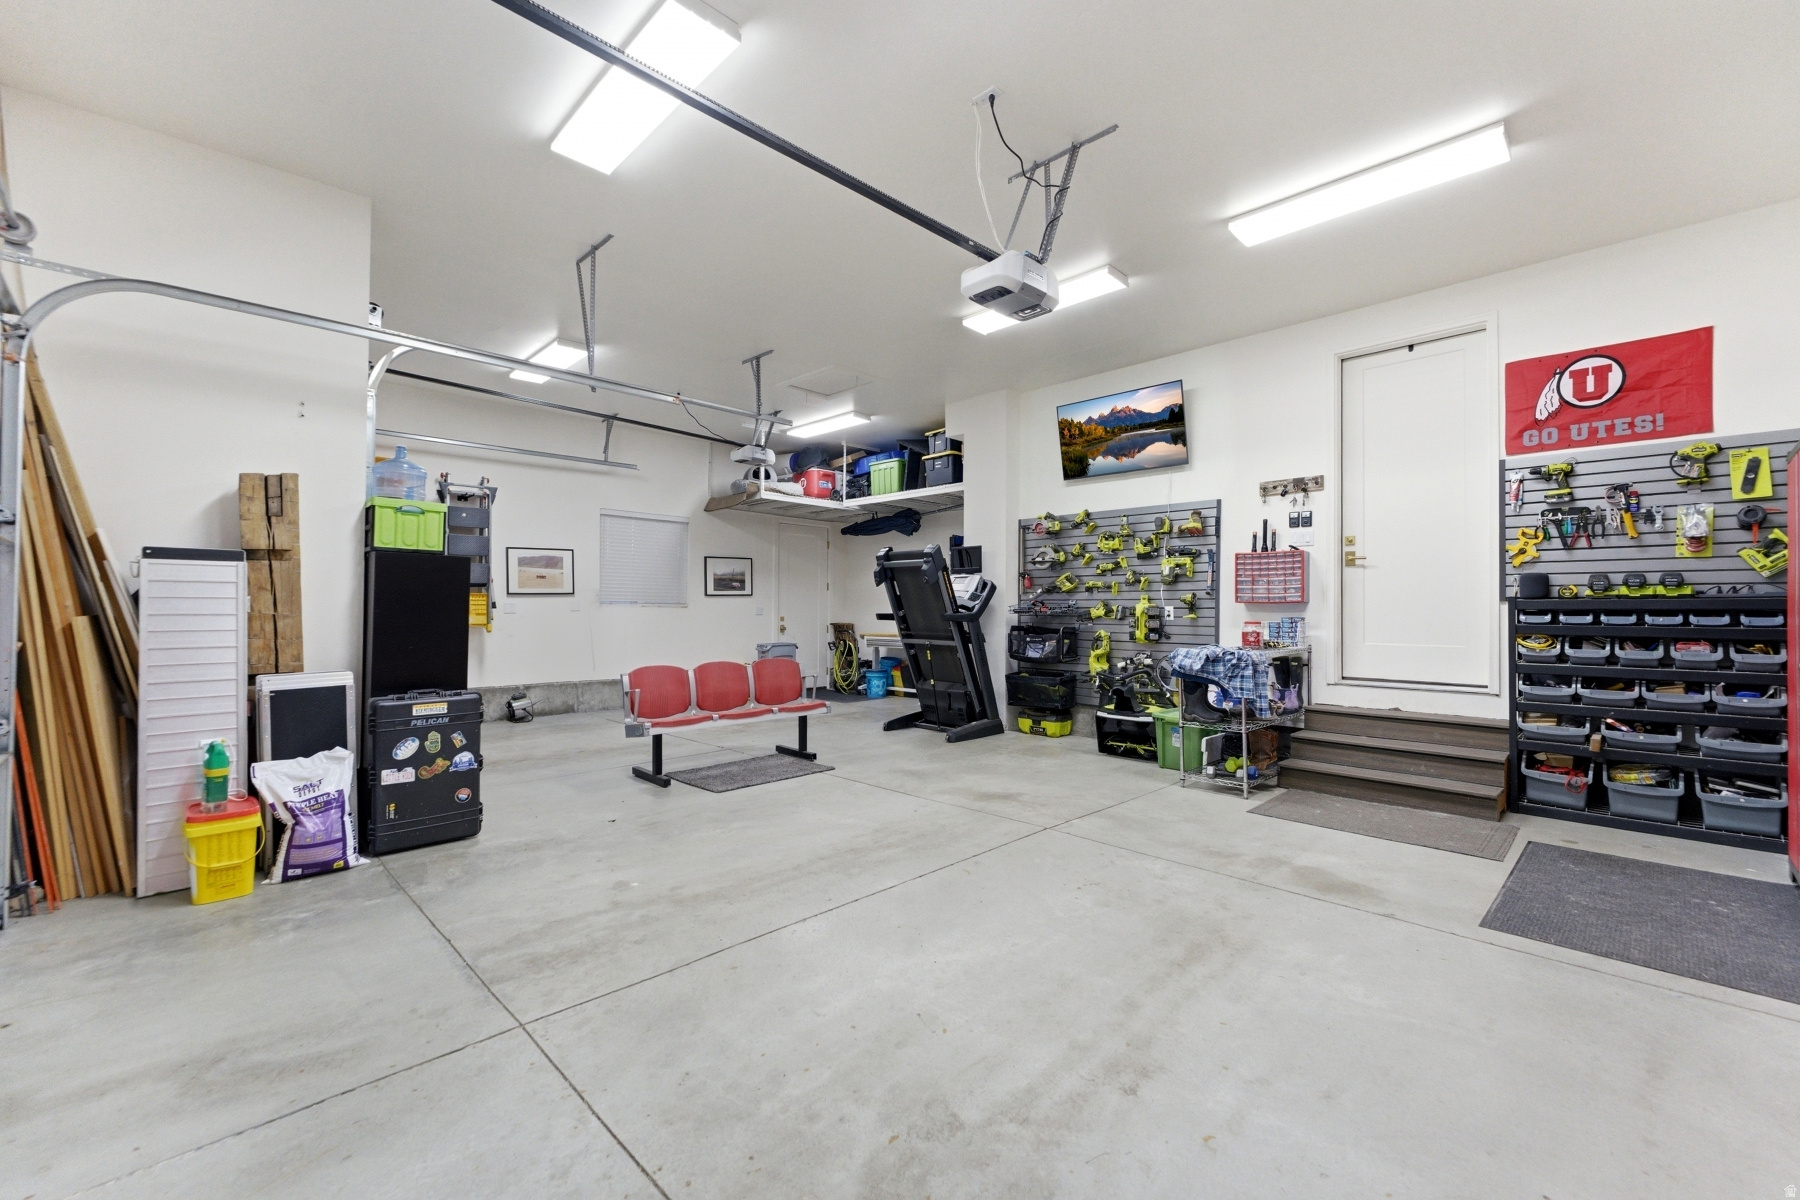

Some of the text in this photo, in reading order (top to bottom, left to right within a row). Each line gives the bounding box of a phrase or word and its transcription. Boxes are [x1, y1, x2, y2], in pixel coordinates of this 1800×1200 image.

[1569, 363, 1612, 402] U
[1522, 413, 1665, 447] GO UTES!
[411, 717, 450, 726] PELICAN
[293, 778, 324, 793] SALT
